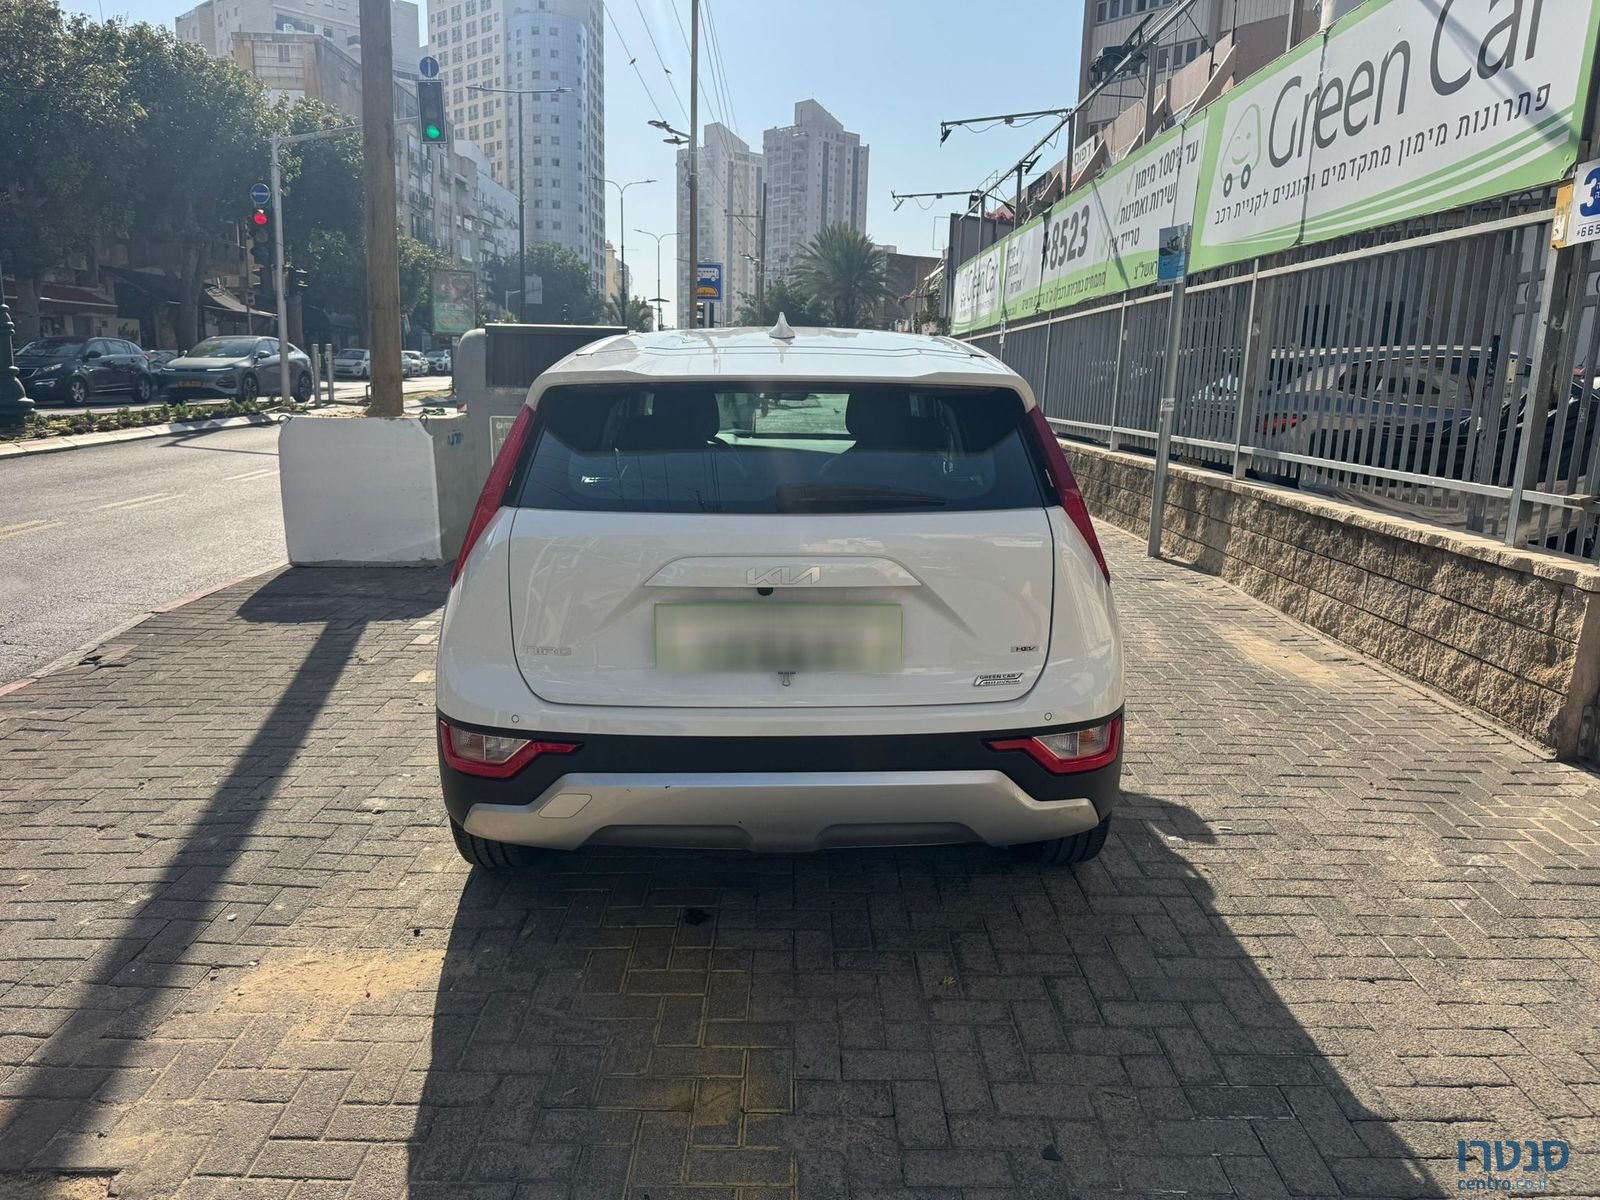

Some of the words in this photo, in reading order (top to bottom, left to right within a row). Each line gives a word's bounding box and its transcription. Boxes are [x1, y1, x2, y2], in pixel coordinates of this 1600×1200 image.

[1268, 40, 1411, 168] Green
[1455, 83, 1551, 139] פתרונות
[1186, 140, 1199, 165] עד
[1398, 123, 1448, 166] מימון
[1134, 163, 1156, 197] מימון
[1321, 144, 1391, 187] מתקדמים
[1119, 195, 1148, 225] ואמינות
[1149, 182, 1177, 212] שירות
[1233, 188, 1269, 217] לקניית
[1214, 206, 1231, 225] רכב
[746, 566, 822, 585] KIA
